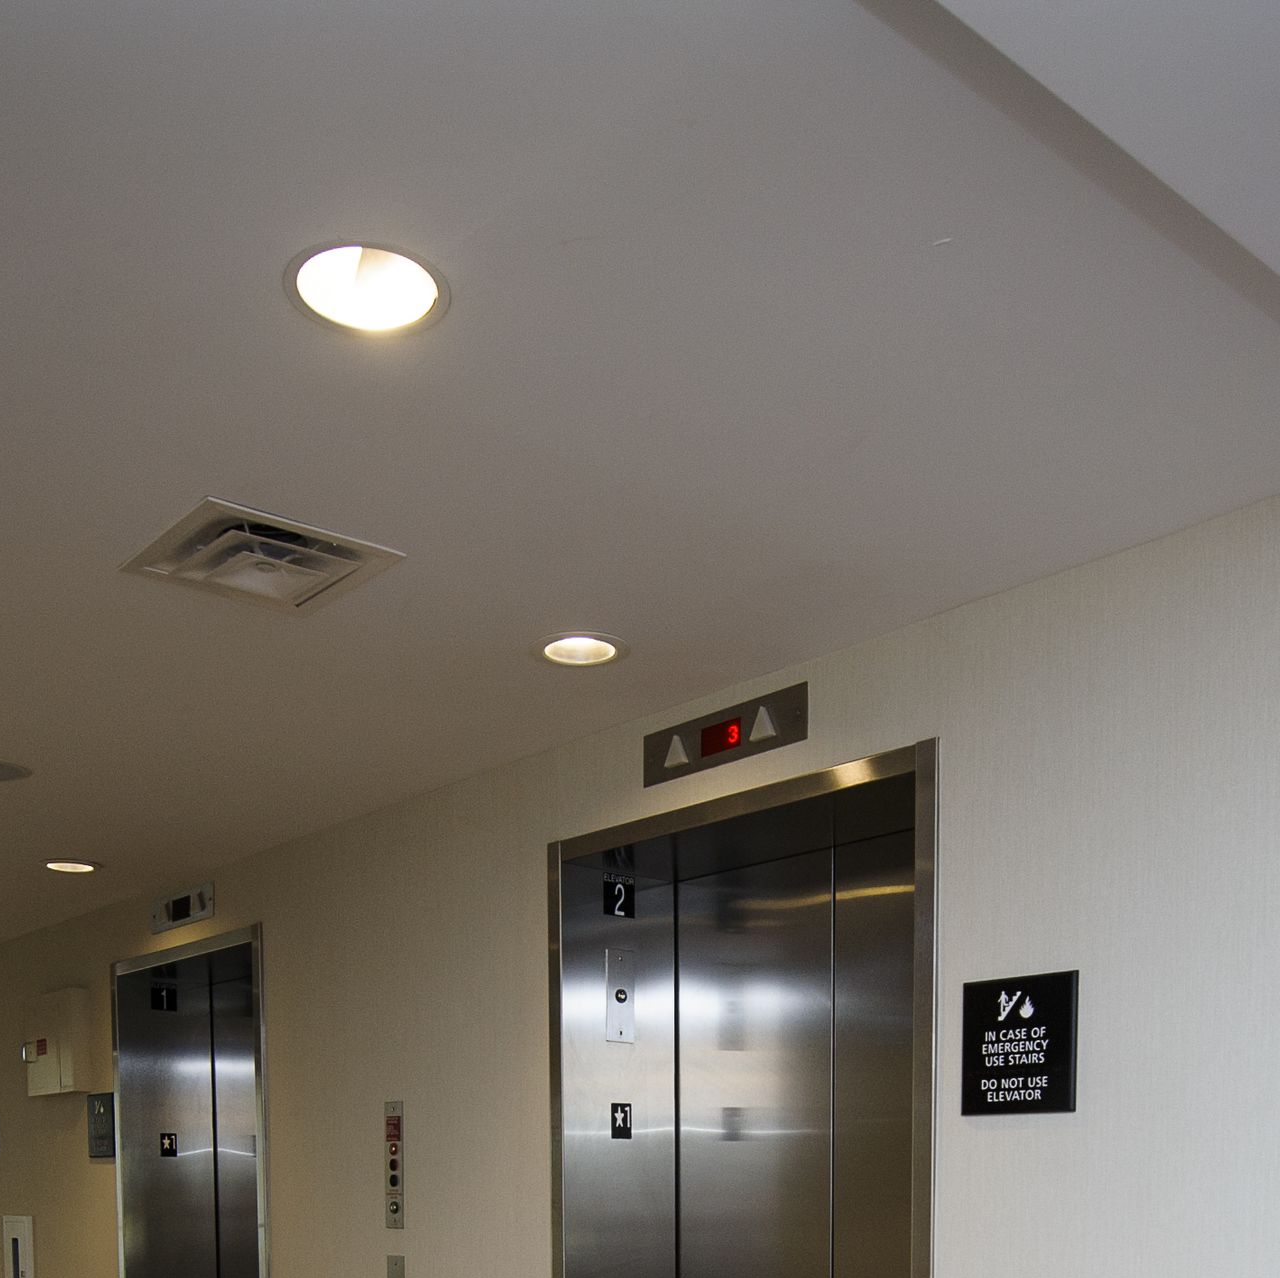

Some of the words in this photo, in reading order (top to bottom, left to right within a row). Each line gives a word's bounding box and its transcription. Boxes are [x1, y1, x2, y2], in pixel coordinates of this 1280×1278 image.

[728, 726, 738, 743] 3
[604, 873, 634, 885] ELEVATOR
[614, 884, 624, 916] 2
[161, 989, 167, 1010] 1
[985, 1031, 996, 1042] IN
[1000, 1028, 1027, 1041] CASE
[1031, 1026, 1046, 1038] OF
[982, 1040, 1049, 1054] EMERGENCY
[985, 1055, 1005, 1067] USE
[1008, 1053, 1045, 1065] STAIRS
[981, 1078, 997, 1090] DO
[1001, 1077, 1024, 1088] NOT
[1028, 1076, 1048, 1087] USE
[987, 1090, 1042, 1102] ELEVATOR
